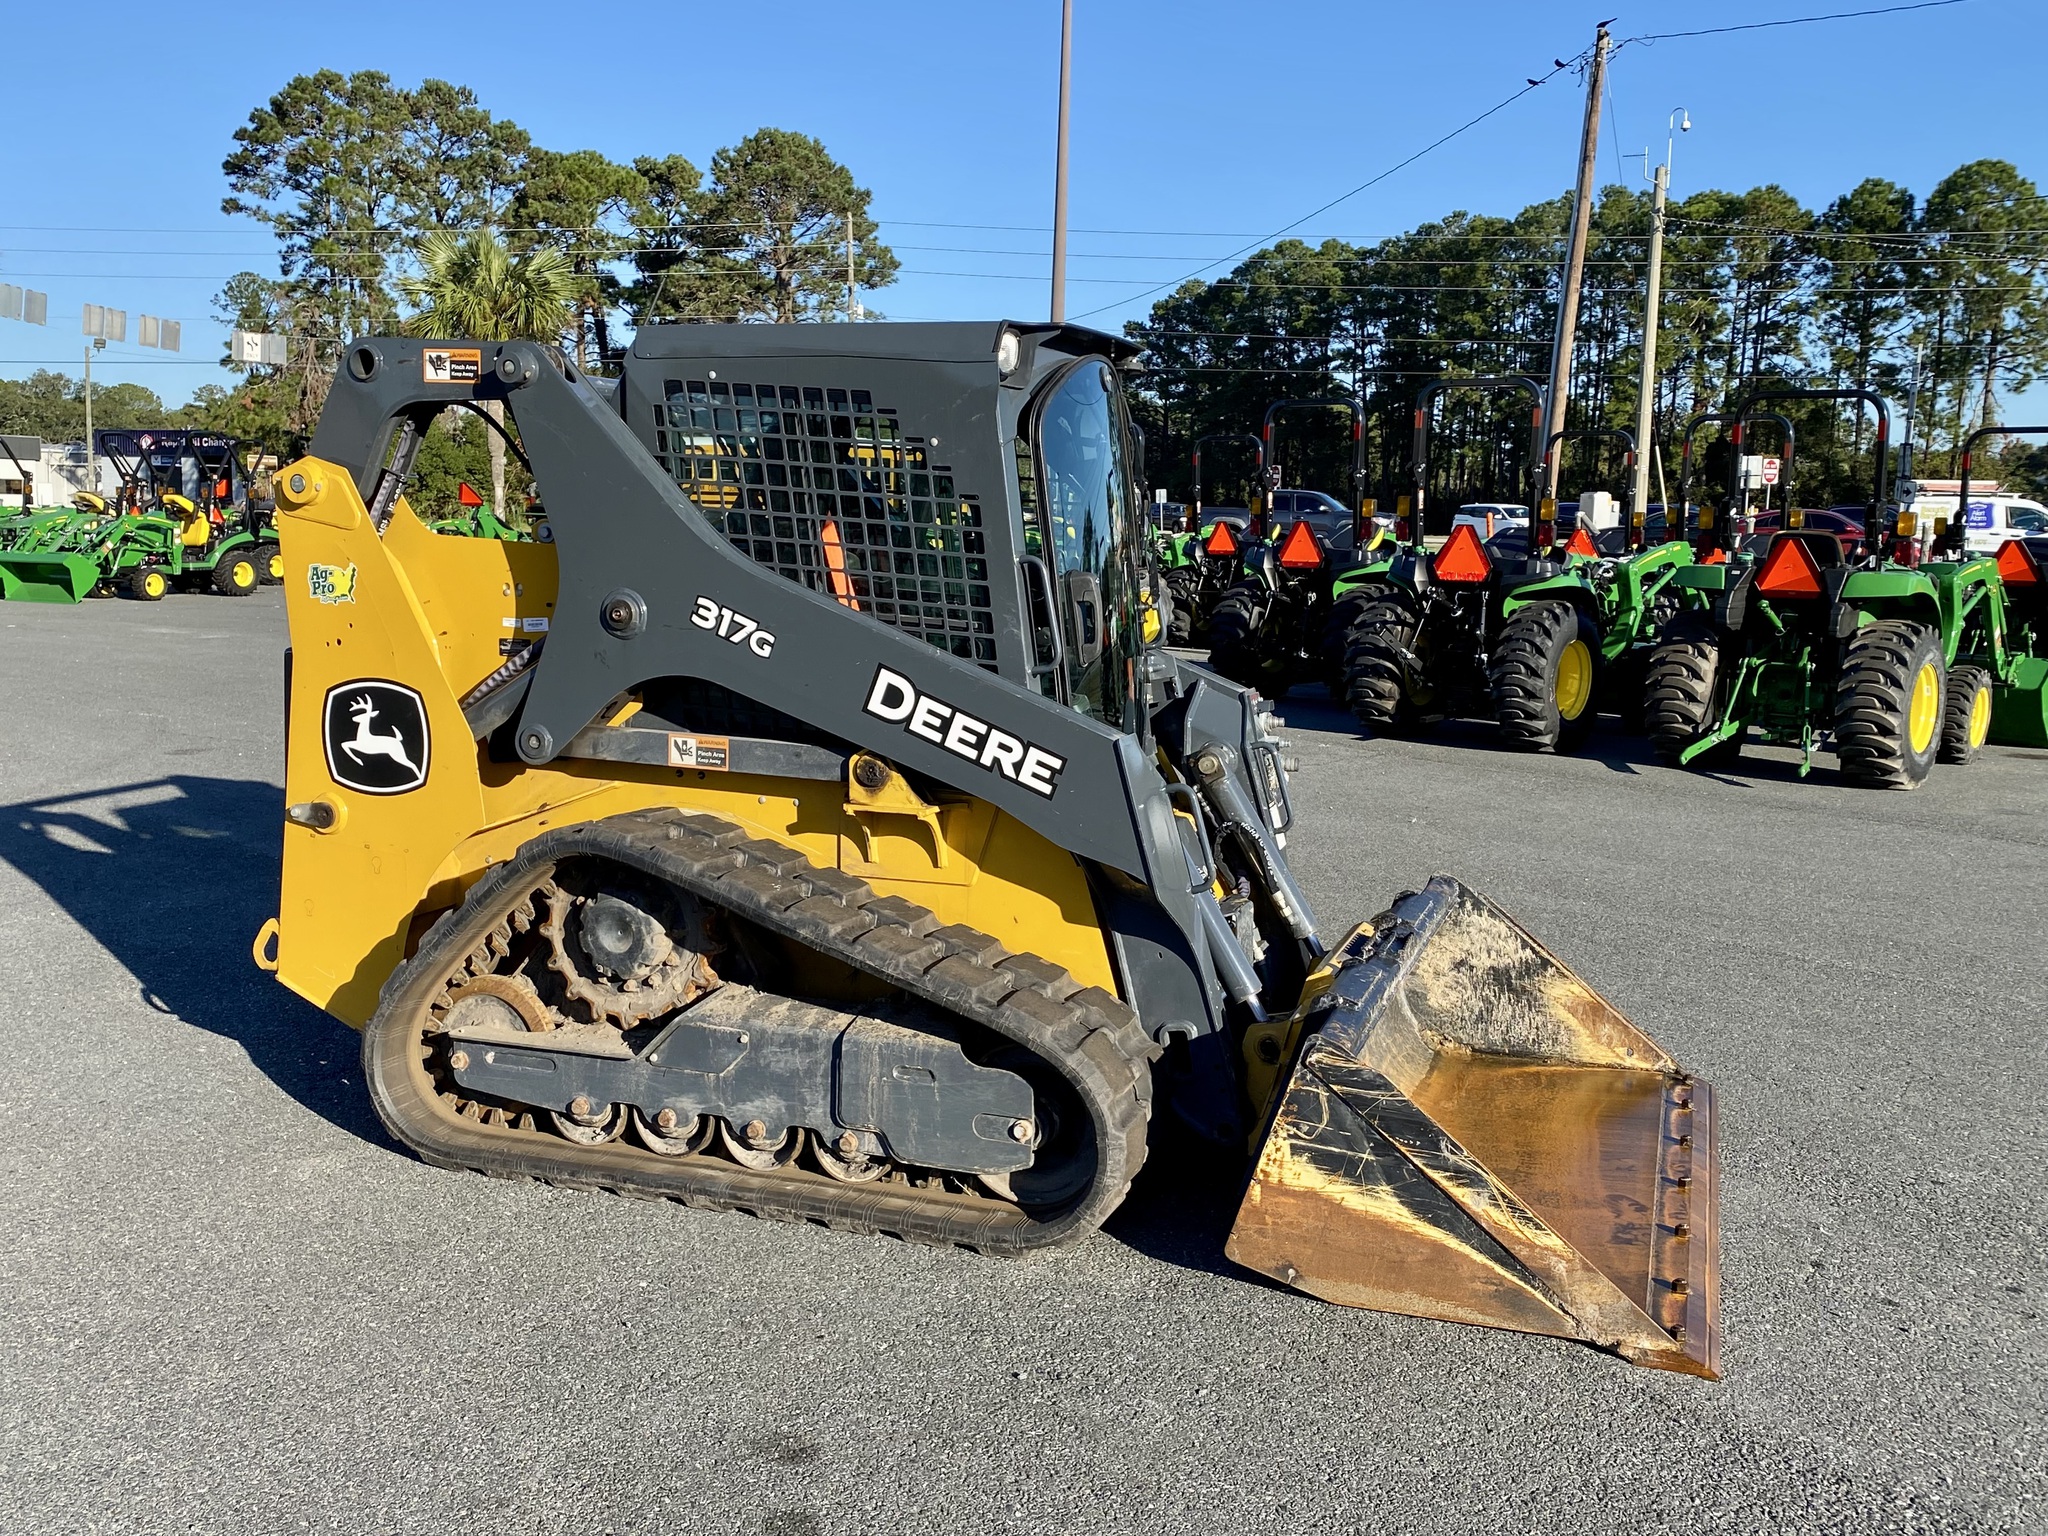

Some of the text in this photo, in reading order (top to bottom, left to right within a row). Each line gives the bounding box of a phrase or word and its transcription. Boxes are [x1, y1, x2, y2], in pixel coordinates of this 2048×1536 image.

[311, 566, 333, 583] Ag-
[312, 580, 335, 595] Pro
[691, 596, 776, 658] 317G
[865, 666, 1065, 797] DEERE
